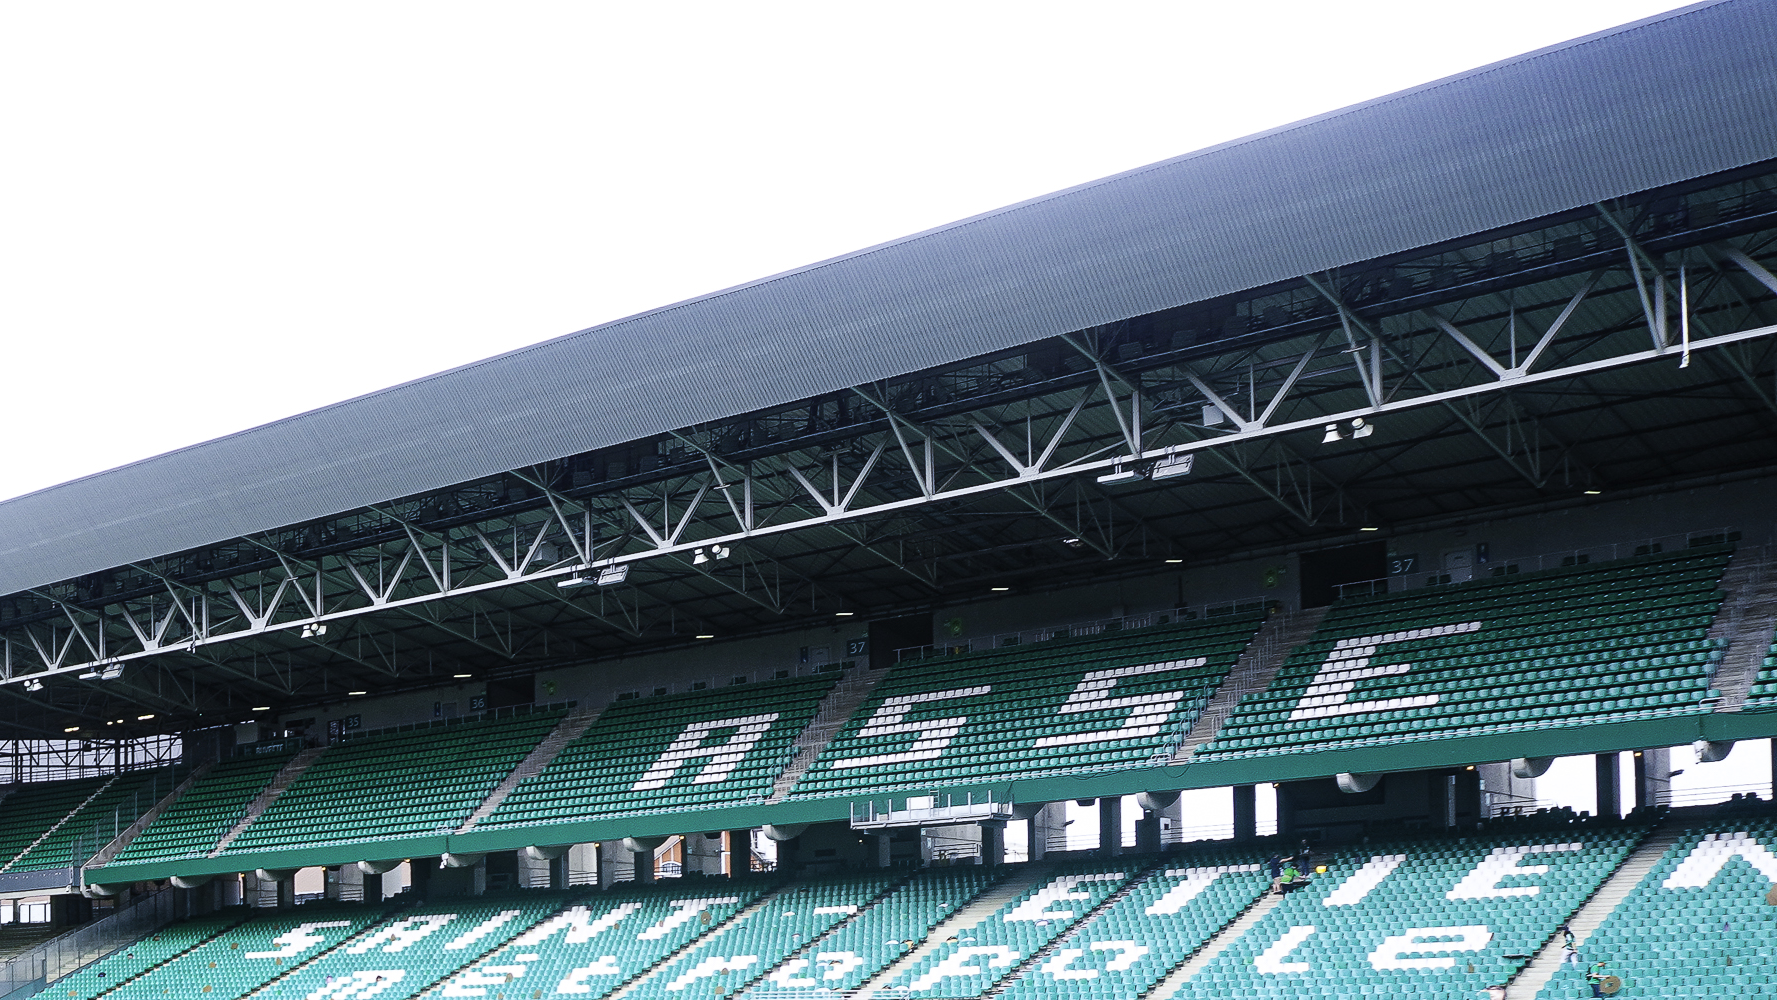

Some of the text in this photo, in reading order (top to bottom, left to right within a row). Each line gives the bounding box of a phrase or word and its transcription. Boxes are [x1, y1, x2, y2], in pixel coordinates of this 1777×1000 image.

[1392, 558, 1414, 574] 37
[850, 641, 865, 654] 37
[472, 698, 484, 709] 36
[633, 621, 1482, 791] ASSE
